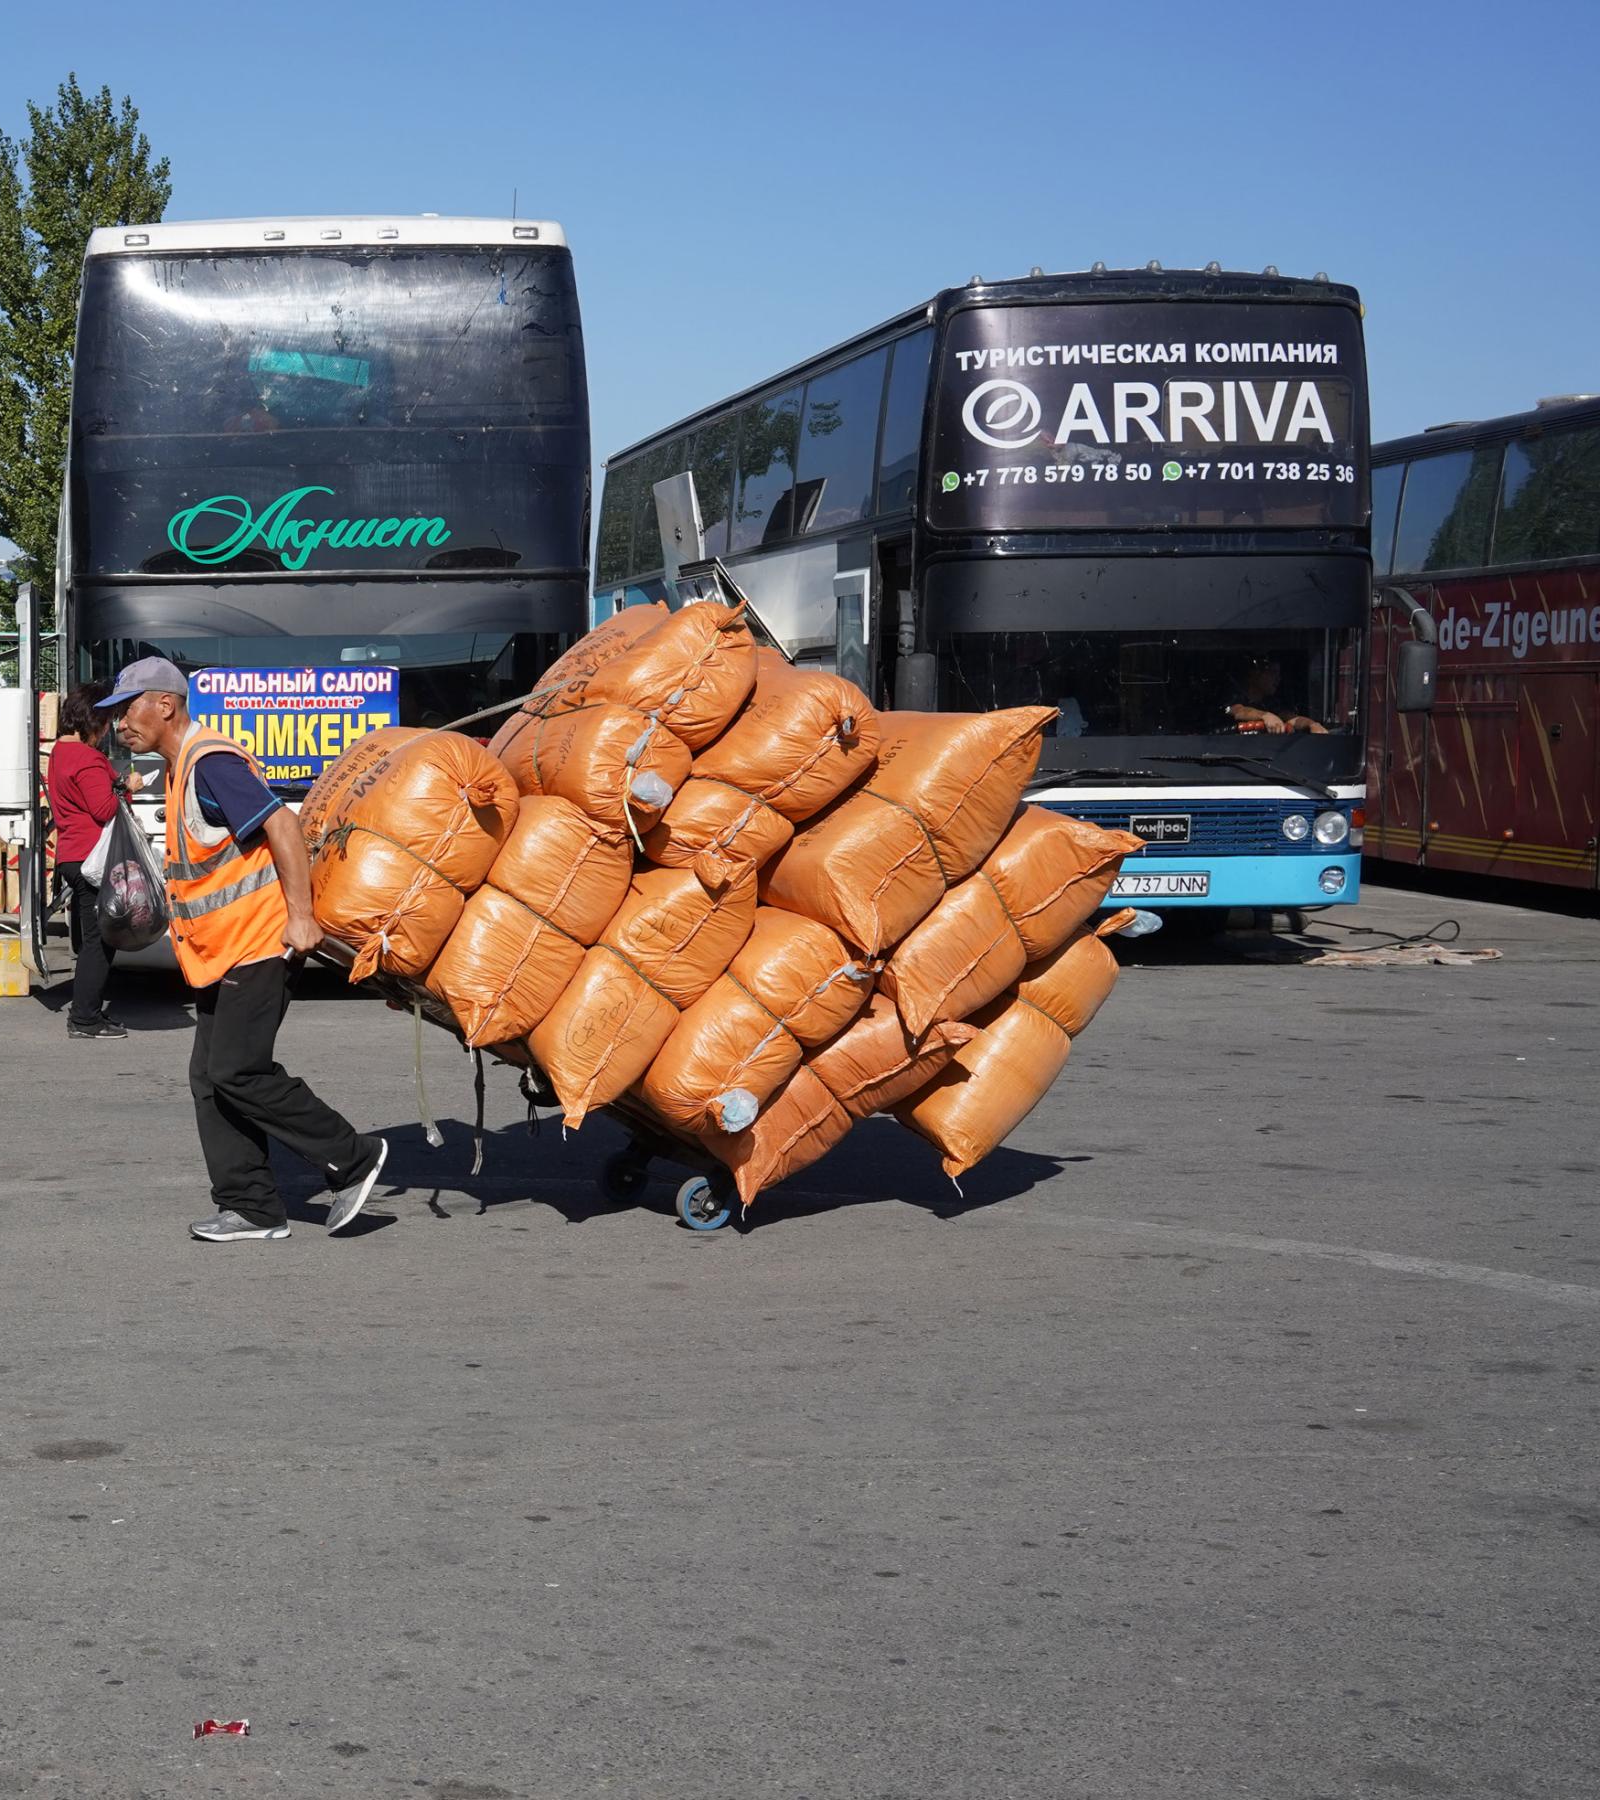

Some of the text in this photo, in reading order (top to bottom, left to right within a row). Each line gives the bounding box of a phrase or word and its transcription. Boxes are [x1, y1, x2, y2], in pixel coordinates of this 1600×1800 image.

[956, 343, 1338, 371] ТУРИСТИЧЕСКАЯ КОМПАНИЯ
[1054, 381, 1334, 443] ARRIVA
[963, 463, 1151, 488] +7 778 579 78 50
[1185, 462, 1354, 484] +7 701 738 25 36
[197, 668, 392, 693] СПАЛЬНЫЙ САЛОН
[223, 695, 366, 710] КОНДИЦИОНЕР
[1132, 877, 1162, 893] 737
[1167, 877, 1204, 893] UNN
